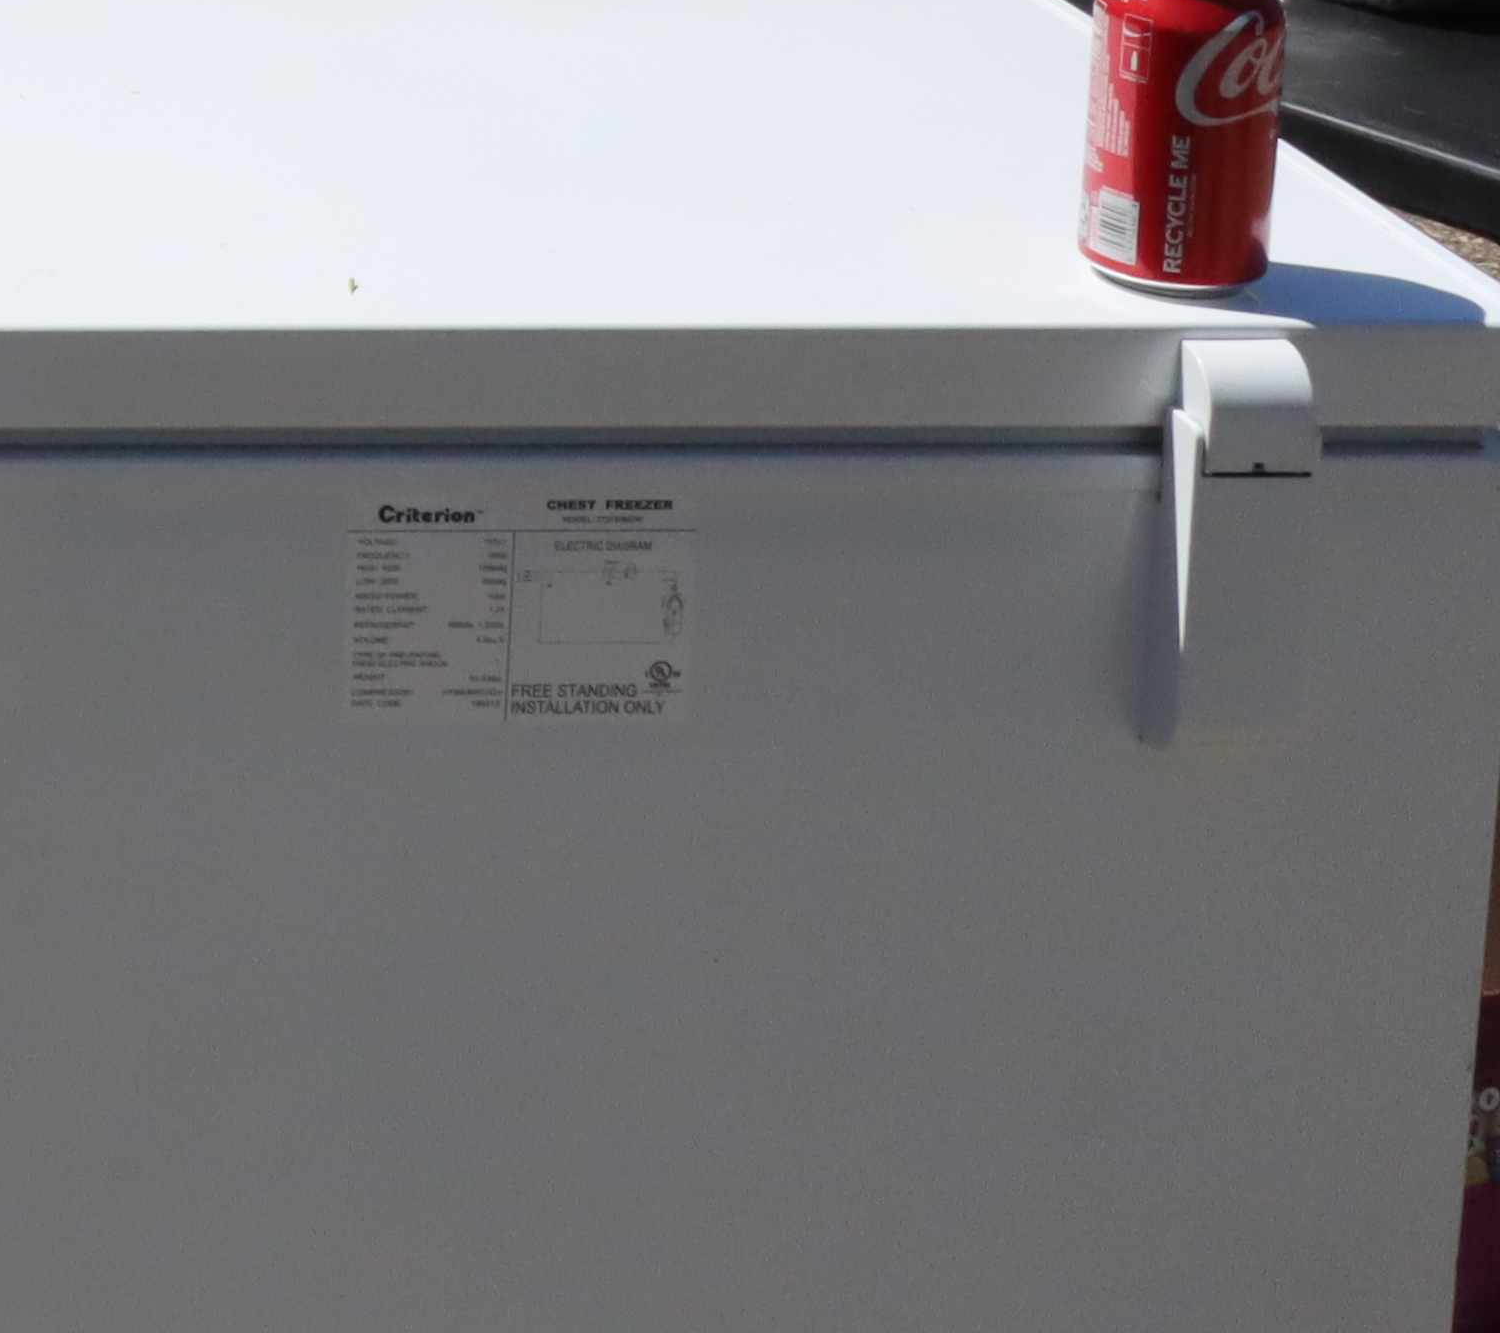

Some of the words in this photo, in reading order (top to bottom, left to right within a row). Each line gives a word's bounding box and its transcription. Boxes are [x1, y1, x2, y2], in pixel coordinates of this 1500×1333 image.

[1170, 135, 1191, 169] ME
[1162, 173, 1188, 274] RECYCLE
[547, 500, 596, 510] CHEST
[605, 500, 673, 510] FREEZER
[378, 505, 475, 523] Criterion
[554, 541, 603, 551] ELECTRIC
[605, 540, 653, 551] DIAGRAM
[511, 684, 552, 698] FREE
[557, 684, 638, 698] STANDING
[511, 700, 619, 714] INSTALLATION
[624, 700, 666, 714] ONLY
